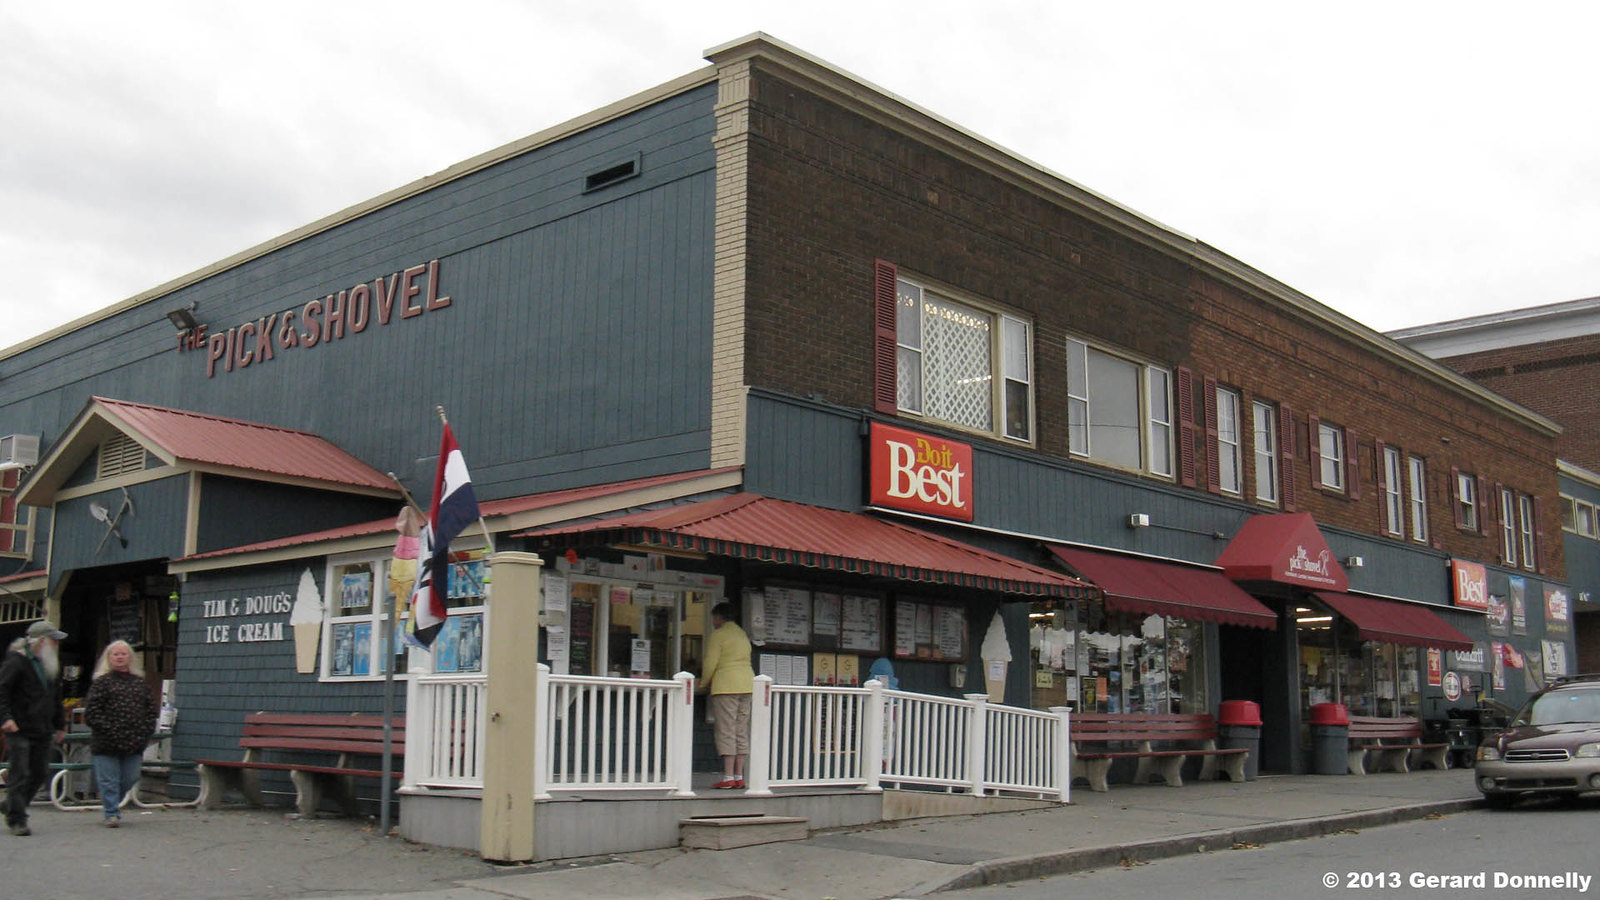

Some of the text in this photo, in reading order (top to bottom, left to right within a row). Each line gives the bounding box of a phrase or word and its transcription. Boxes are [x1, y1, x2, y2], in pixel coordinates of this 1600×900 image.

[176, 324, 208, 353] THE
[206, 313, 277, 378] PICK
[300, 259, 451, 348] SHOVEL
[917, 438, 941, 466] Do
[886, 440, 965, 508] Best
[1458, 569, 1485, 603] Best
[203, 600, 226, 617] TIM
[245, 592, 292, 615] DOUG'S
[206, 622, 283, 643] ICE CREAM
